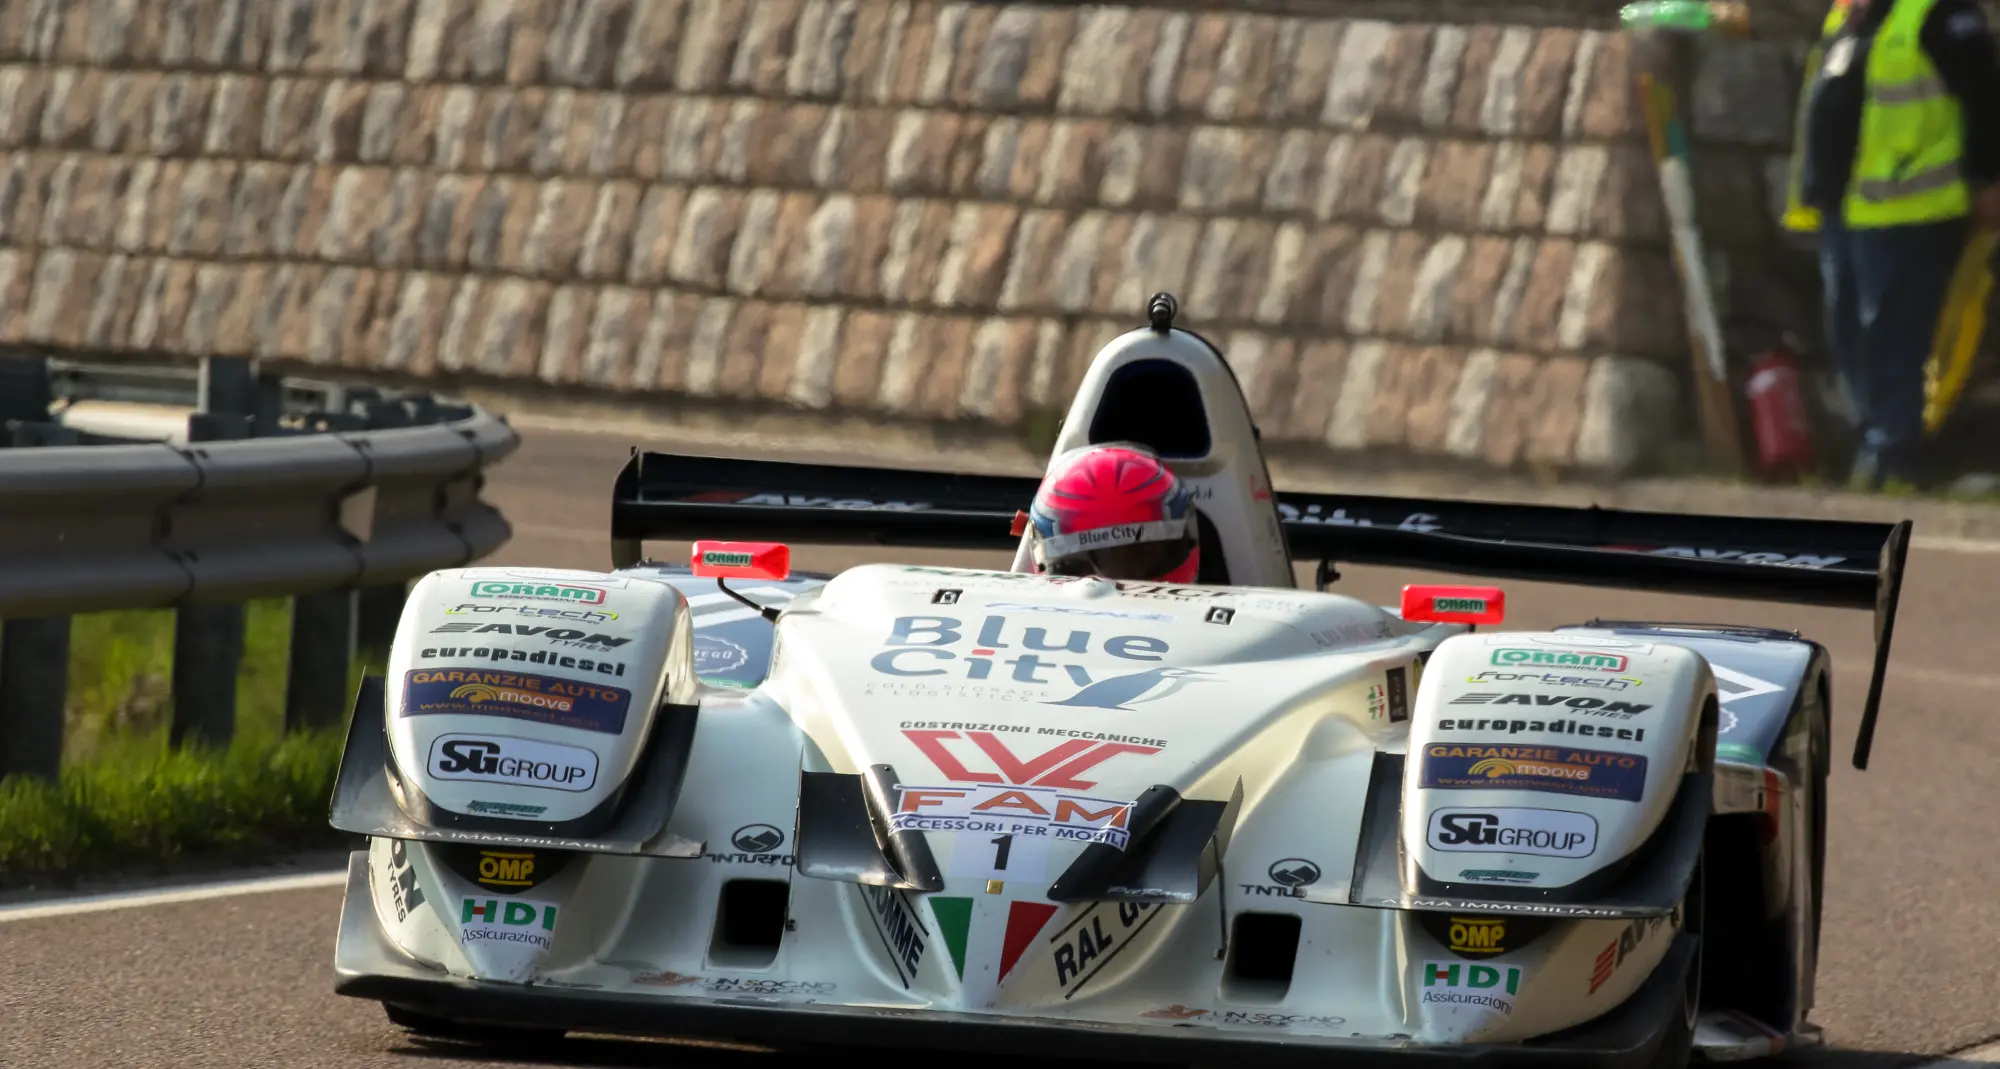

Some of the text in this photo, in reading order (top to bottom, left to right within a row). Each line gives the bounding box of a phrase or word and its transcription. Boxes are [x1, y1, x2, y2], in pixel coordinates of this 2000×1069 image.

[705, 552, 749, 565] ORAM
[1652, 547, 1847, 569] AVON
[482, 581, 597, 600] ORAM
[455, 603, 606, 622] fortech
[1438, 599, 1483, 611] ORAM
[472, 623, 634, 648] AVON
[549, 639, 613, 652] TYRES
[885, 615, 1170, 661] Blue
[421, 647, 625, 677] europadiesel
[1503, 650, 1618, 668] ORAM
[412, 671, 619, 702] GARANZIE AUTO
[1477, 671, 1628, 690] fortech
[500, 691, 572, 712] moove
[1491, 693, 1654, 715] AVON
[1570, 708, 1633, 719] TYRES
[899, 720, 1168, 749] COSTRUZIONI MECCANICHE
[1438, 718, 1645, 742] europadiesel
[439, 740, 587, 784] SG GROUP
[1430, 746, 1636, 769] GARANZIE AUTO
[1516, 762, 1589, 780] moove
[901, 790, 1129, 829] FAM
[891, 817, 1004, 833] ACCESSORI
[1011, 824, 1048, 836] PER
[1438, 814, 1586, 852] SG GROUP
[989, 834, 1014, 871] 1
[391, 839, 427, 914] ON
[479, 857, 535, 881] OMP
[388, 857, 406, 923] TYRES
[461, 898, 557, 931] HDI
[461, 927, 553, 951] Assicurazioni
[1449, 924, 1504, 948] OMP
[1054, 915, 1113, 988] RAL
[1424, 963, 1520, 996] HDI
[1422, 991, 1513, 1014] Assicurazioni
